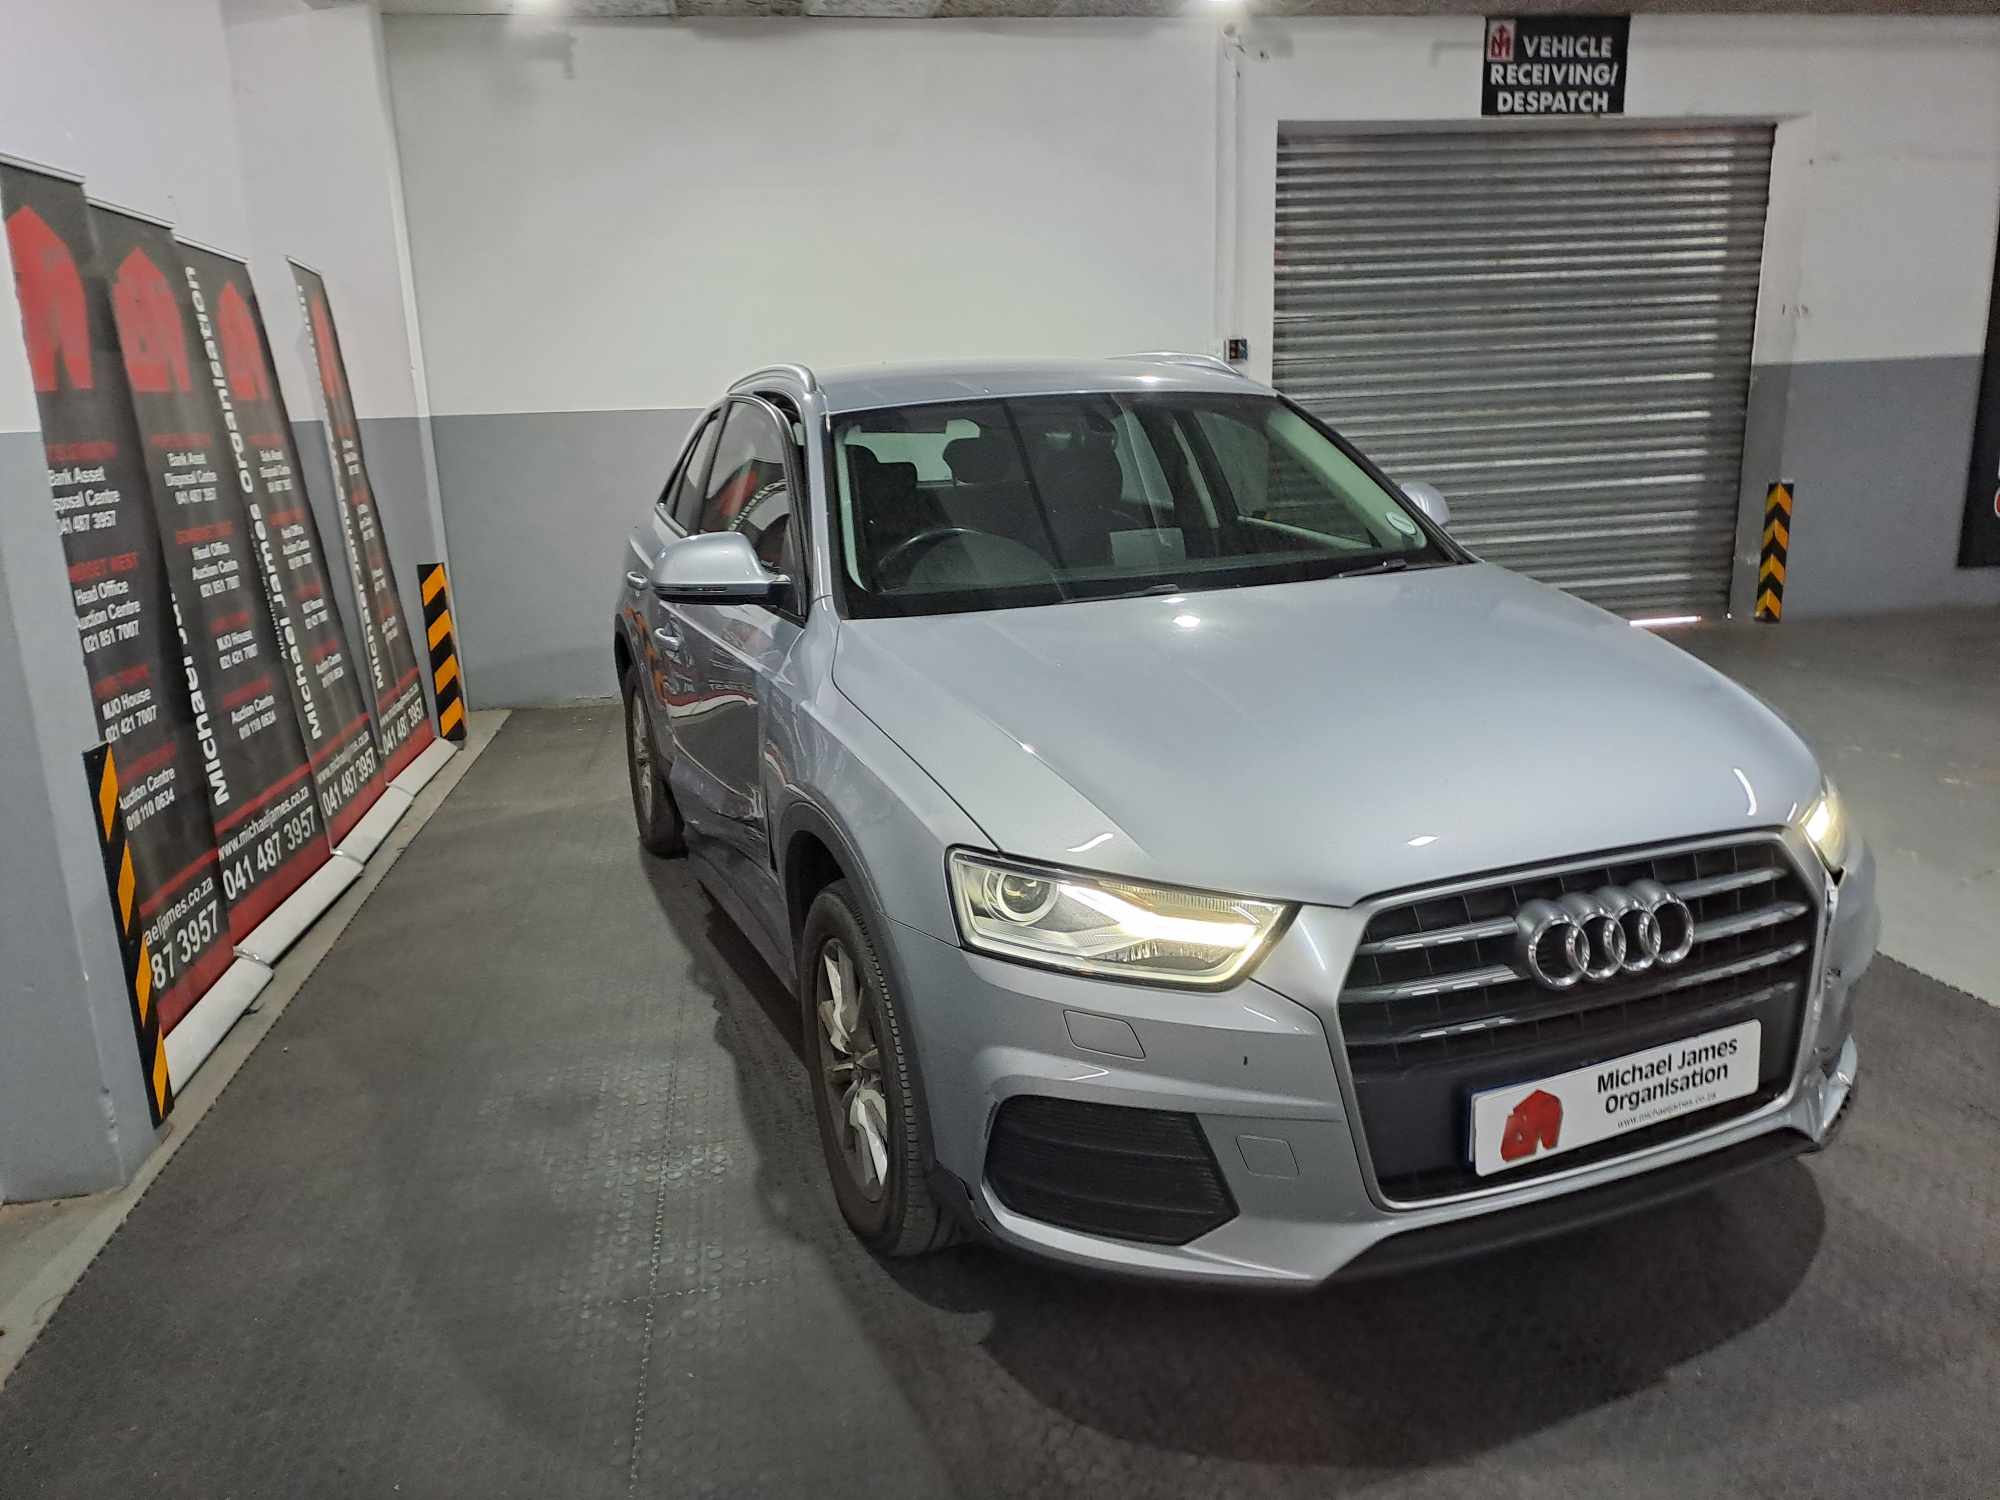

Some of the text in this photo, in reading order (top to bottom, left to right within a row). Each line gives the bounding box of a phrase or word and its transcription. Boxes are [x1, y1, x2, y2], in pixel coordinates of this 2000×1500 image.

[1523, 35, 1613, 58] VEHICLE
[1490, 62, 1618, 86] RECEIVING/
[1497, 91, 1608, 113] DESPATCH
[85, 489, 120, 505] Centre
[98, 579, 129, 599] Office
[80, 600, 141, 630] uction Centre
[146, 768, 176, 790] Centre
[322, 747, 377, 818] 041 487 3957
[222, 805, 316, 900] 041 487 3957
[145, 876, 214, 947] aeljames.co.za
[152, 901, 219, 990] 87 3957
[1597, 1038, 1738, 1095] Michael James
[1605, 1062, 1729, 1114] Organisation
